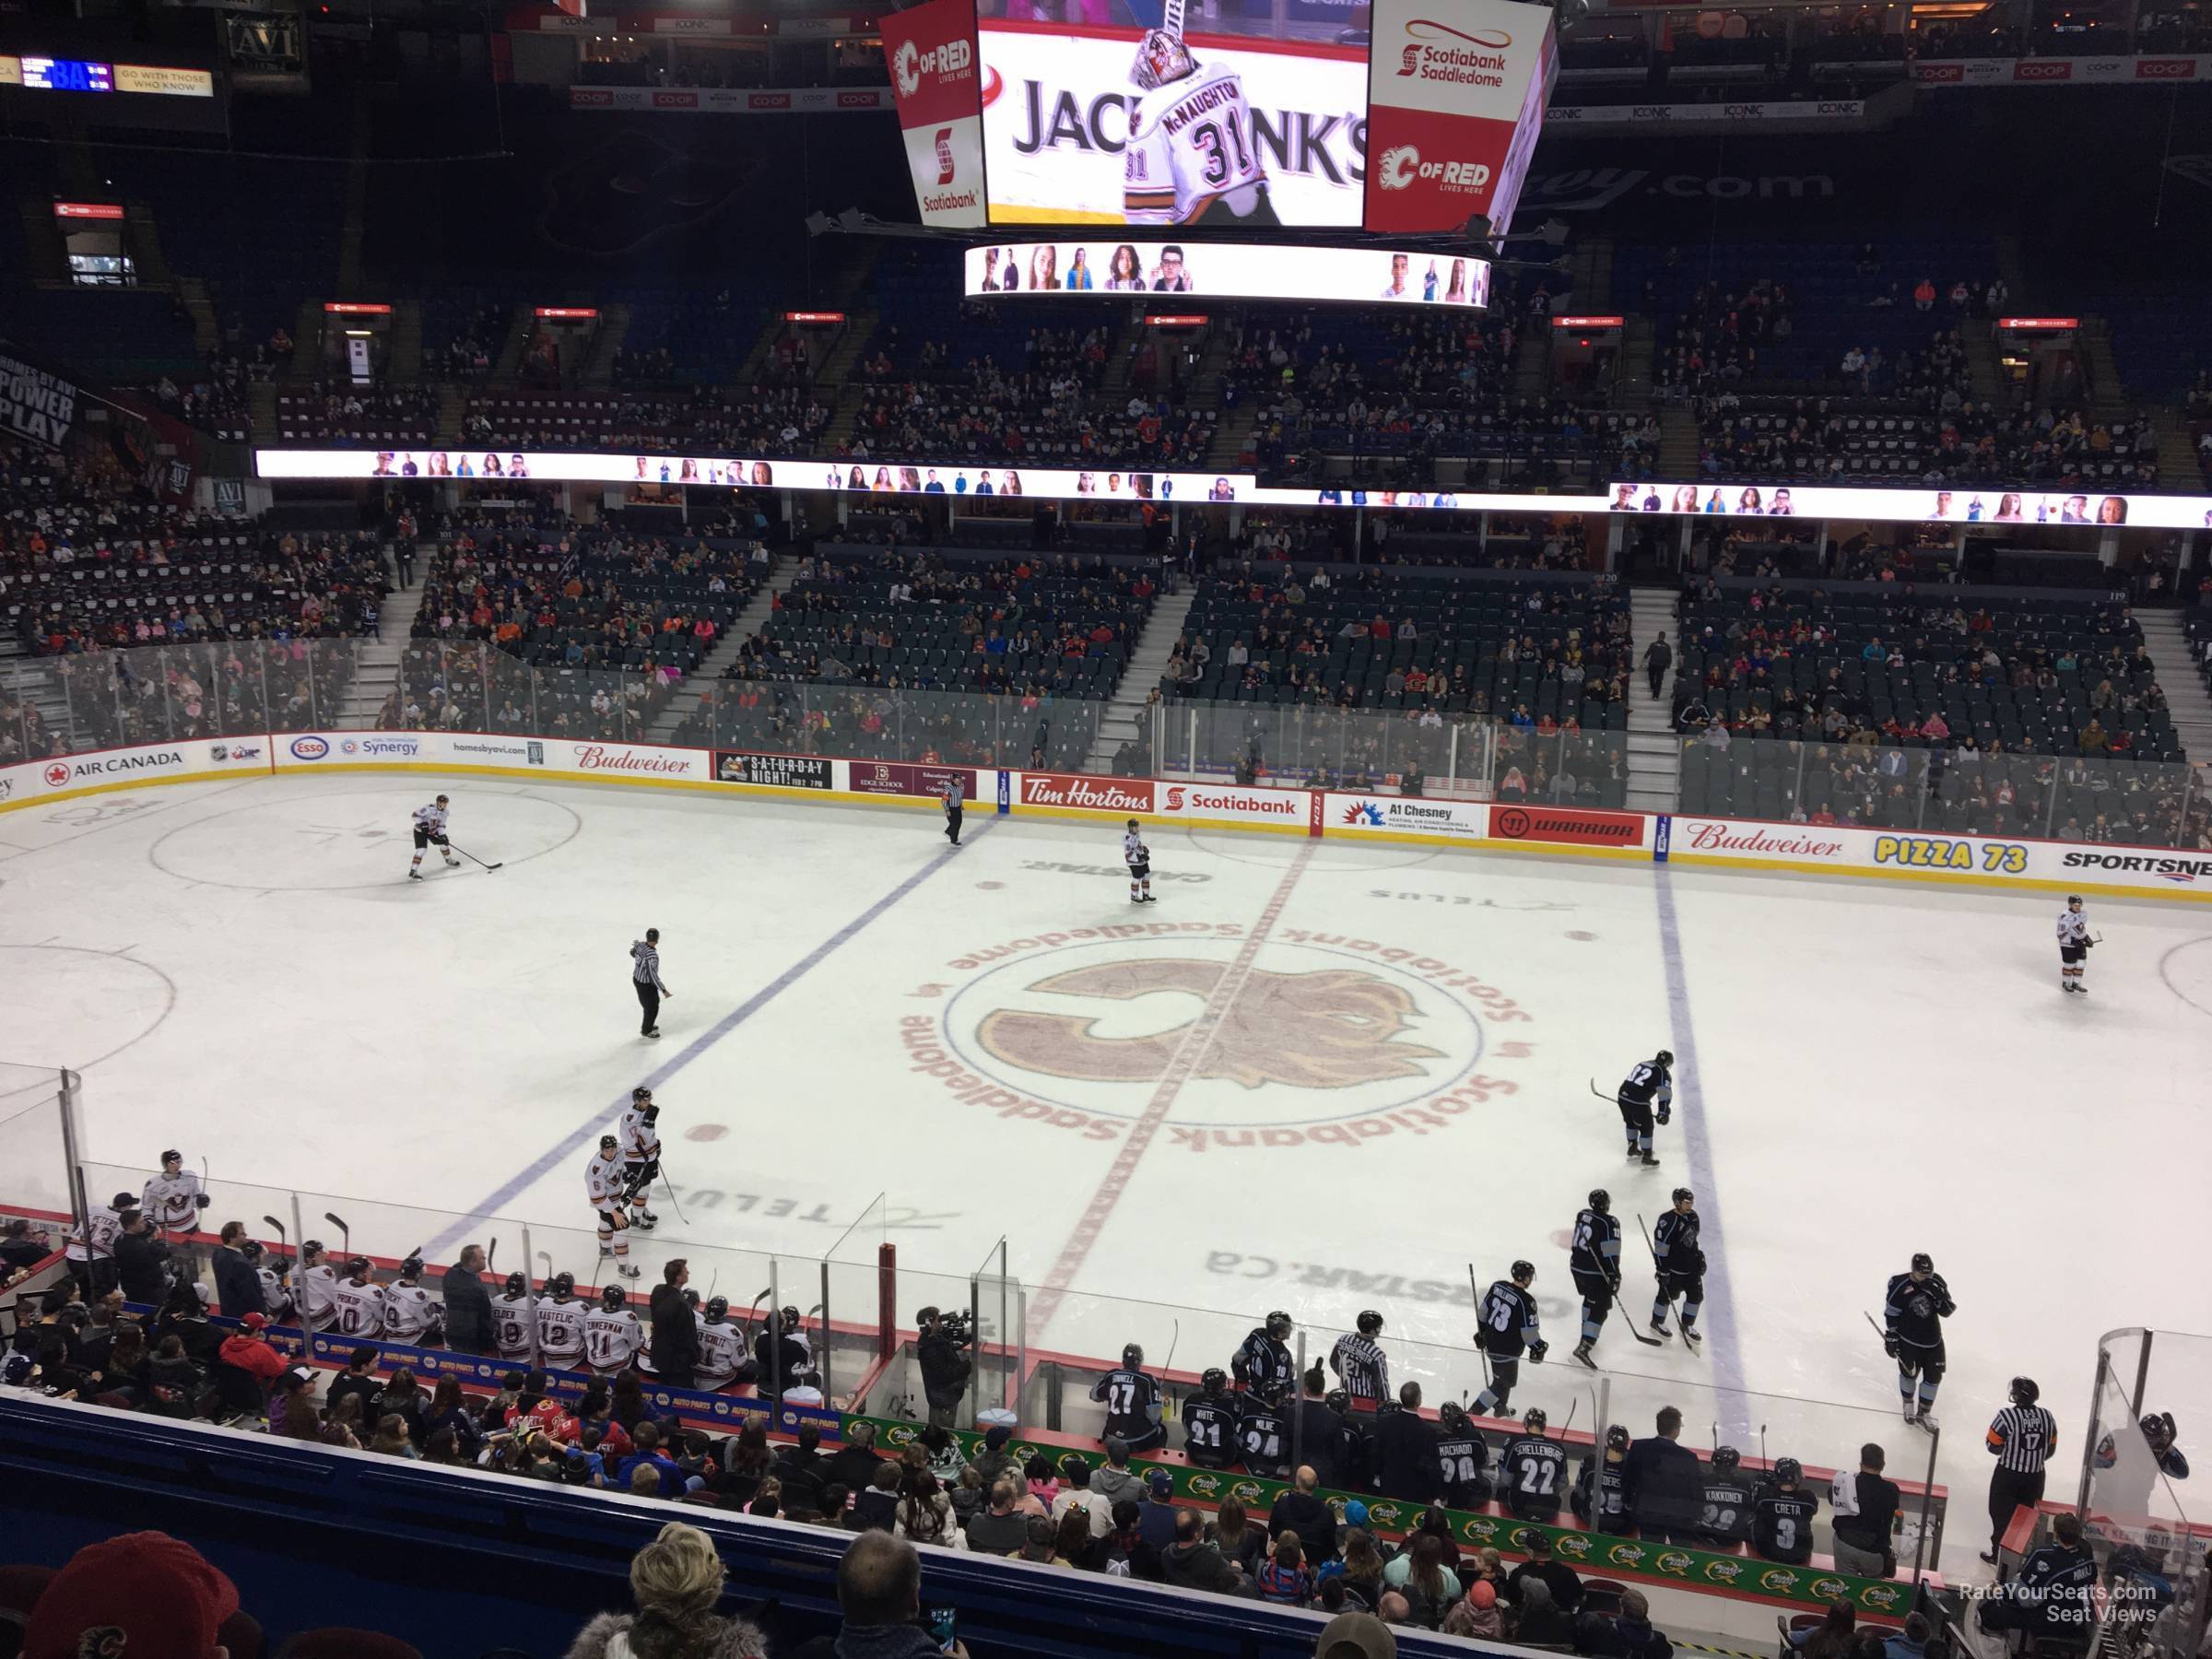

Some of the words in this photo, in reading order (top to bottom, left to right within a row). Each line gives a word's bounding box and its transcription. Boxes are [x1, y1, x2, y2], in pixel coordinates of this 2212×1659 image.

[676, 19, 709, 29] ICONIC
[236, 29, 295, 56] AVI
[921, 51, 936, 74] OF
[936, 40, 971, 74] RED
[1424, 46, 1506, 70] Scotiabank
[122, 70, 142, 79] GO
[145, 71, 168, 81] WITH
[171, 74, 205, 83] THOSE
[938, 74, 956, 84] LIVES
[957, 69, 971, 80] HERE
[1420, 65, 1503, 87] Saddledome
[2021, 65, 2065, 76] CO-OP
[2144, 65, 2188, 75] CO-OP
[134, 80, 159, 89] WHO
[162, 82, 196, 91] KNOW
[574, 93, 608, 105] CO-OP
[658, 95, 692, 106] CO-OP
[754, 97, 785, 107] CO-OP
[842, 94, 876, 104] CO-OP
[1818, 102, 1858, 113] ICONIC
[1012, 79, 1143, 155] JAC
[1547, 109, 1582, 119] CONIC
[1633, 107, 1672, 118] ICONIC
[1724, 104, 1764, 116] ICONIC
[1191, 106, 1253, 189] 31
[1126, 148, 1148, 182] 31
[1419, 162, 1443, 179] OF
[1442, 161, 1489, 185] RED
[1440, 184, 1462, 193] LIVES
[1464, 186, 1484, 194] HERE
[924, 190, 977, 212] Scotiabank
[41, 371, 54, 389] BY
[56, 377, 76, 398] AVI
[0, 371, 74, 422] POWER
[0, 397, 70, 446] PLAY
[218, 482, 243, 502] AVI
[2111, 592, 2125, 601] 119
[363, 741, 418, 756] Synergy
[453, 742, 526, 757] homesbyavi.com
[75, 762, 103, 777] AIR
[106, 751, 182, 772] CANADA
[574, 745, 690, 774] Budweiser
[751, 770, 790, 784] NIGHT!
[878, 781, 904, 789] SCHOOL
[1026, 779, 1064, 804] Tim
[1066, 780, 1148, 810] Hortons
[1192, 794, 1296, 815] Scotiabank
[1312, 795, 1321, 827] CCM
[1389, 804, 1402, 815] A1
[1405, 805, 1453, 820] Chesney
[1534, 820, 1634, 836] WARRIOR
[1687, 823, 1844, 856] Budweiser
[1875, 836, 1973, 869] PIZZA
[1983, 843, 2029, 873] 73
[1370, 890, 1497, 907] TELUS
[947, 919, 1244, 971] Saddledome
[1279, 927, 1534, 1024] Scotiabank
[899, 1014, 1130, 1143] Saddledome
[1169, 1075, 1521, 1151] Scotiabank
[651, 1184, 831, 1223] TELUS
[540, 1322, 568, 1347] 12
[591, 1332, 611, 1359] 11
[440, 1361, 455, 1370] AUTO
[456, 1363, 475, 1372] PARTS
[1277, 1365, 1287, 1377] 19
[559, 1380, 575, 1388] AUTO
[672, 1398, 689, 1407] AUTO
[690, 1400, 711, 1410] PARTS
[1110, 1384, 1135, 1414] 27
[732, 1406, 748, 1416] AUTO
[749, 1409, 771, 1419] PARTS
[1196, 1409, 1215, 1421] WHITE
[800, 1417, 818, 1426] AUTO
[818, 1419, 840, 1429] PARTS
[2023, 1418, 2041, 1429] PAPP
[1191, 1421, 1220, 1447] 21
[2025, 1433, 2041, 1450] 17
[1247, 1431, 1279, 1457] 24
[1439, 1444, 1473, 1455] MACHADO
[1521, 1460, 1556, 1494] 22
[1705, 1490, 1743, 1504] KAKKONEN
[1775, 1503, 1801, 1515] CRETA
[1776, 1518, 1796, 1549] 3
